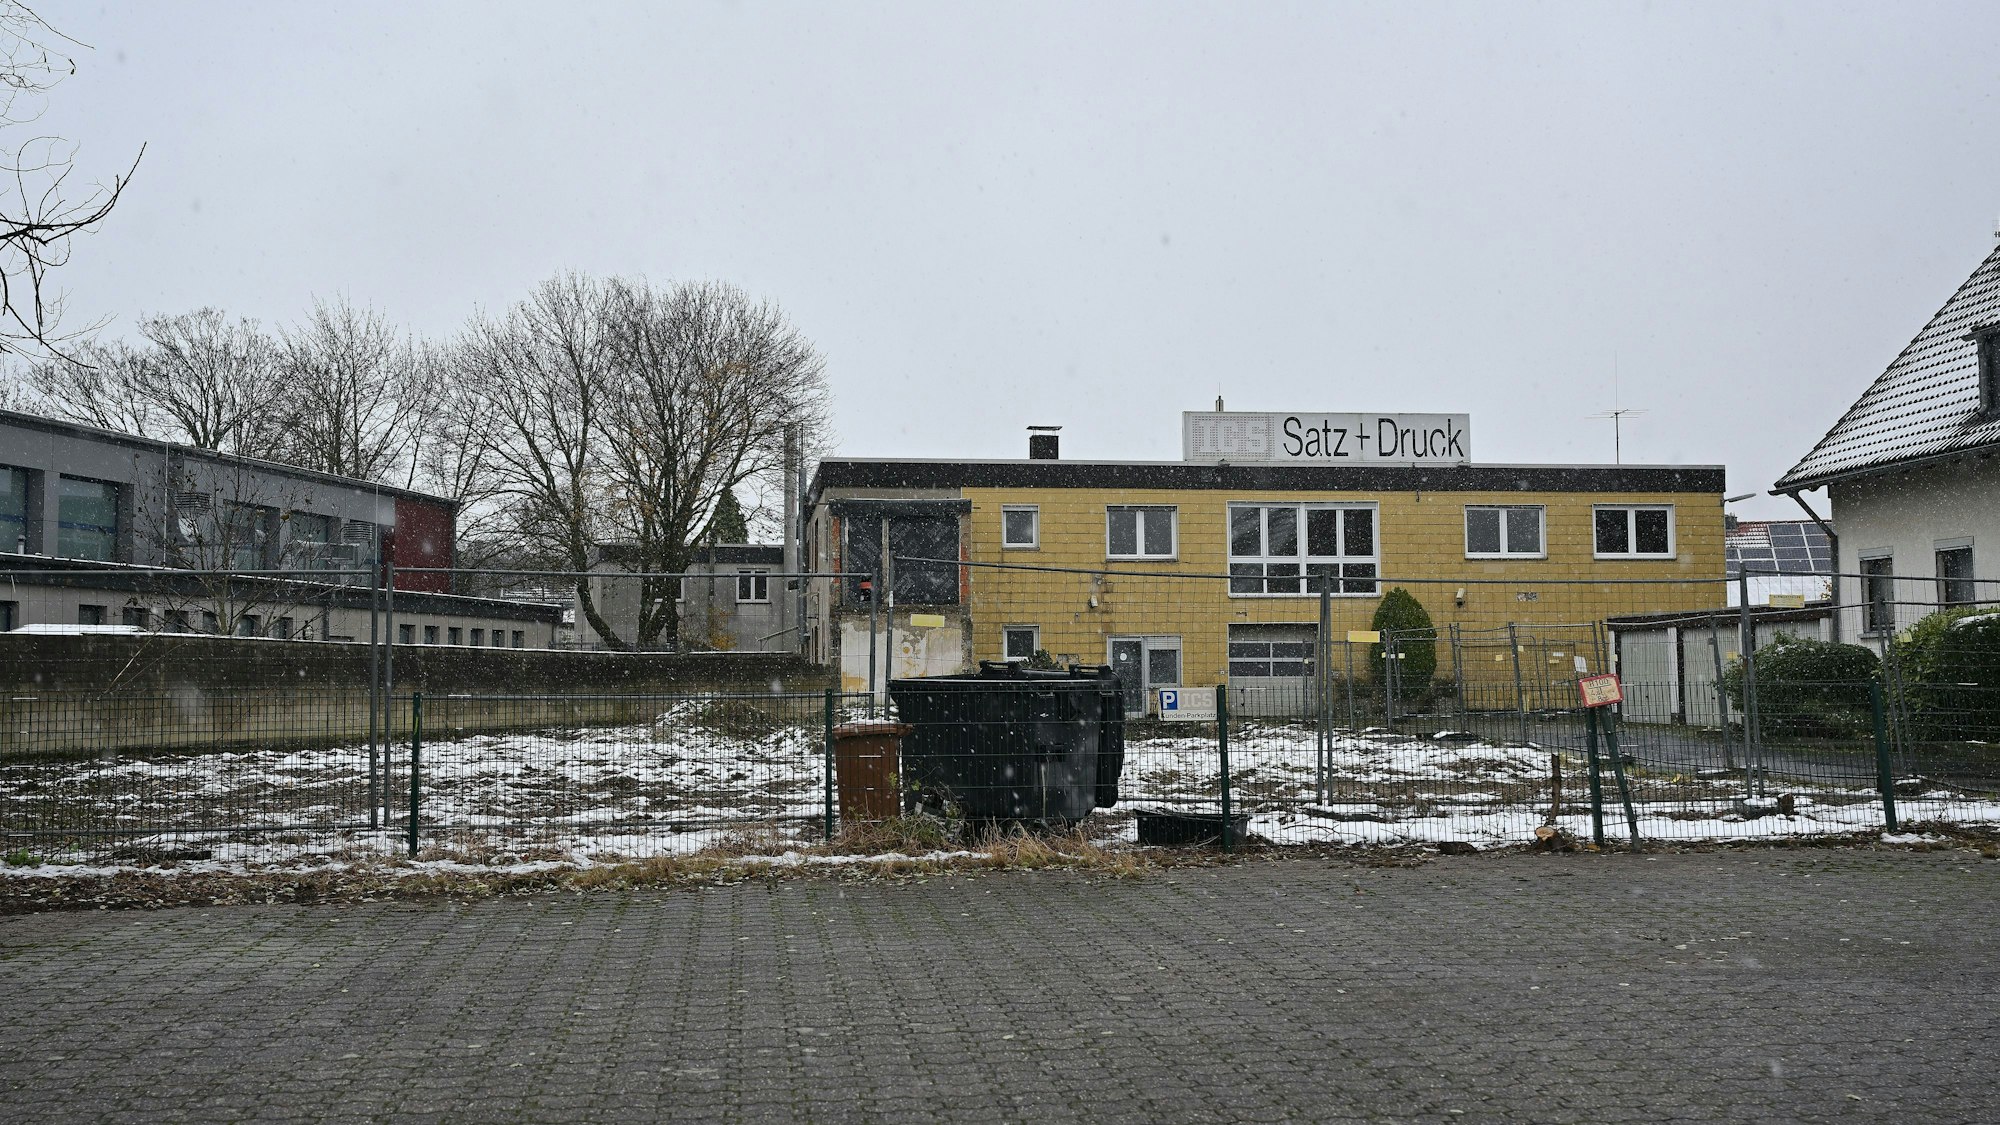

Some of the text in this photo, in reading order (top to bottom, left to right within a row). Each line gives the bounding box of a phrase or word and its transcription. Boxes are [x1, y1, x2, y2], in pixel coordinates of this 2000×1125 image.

[1199, 416, 1464, 458] ICS Satz + Druck
[1162, 692, 1213, 709] P ICS
